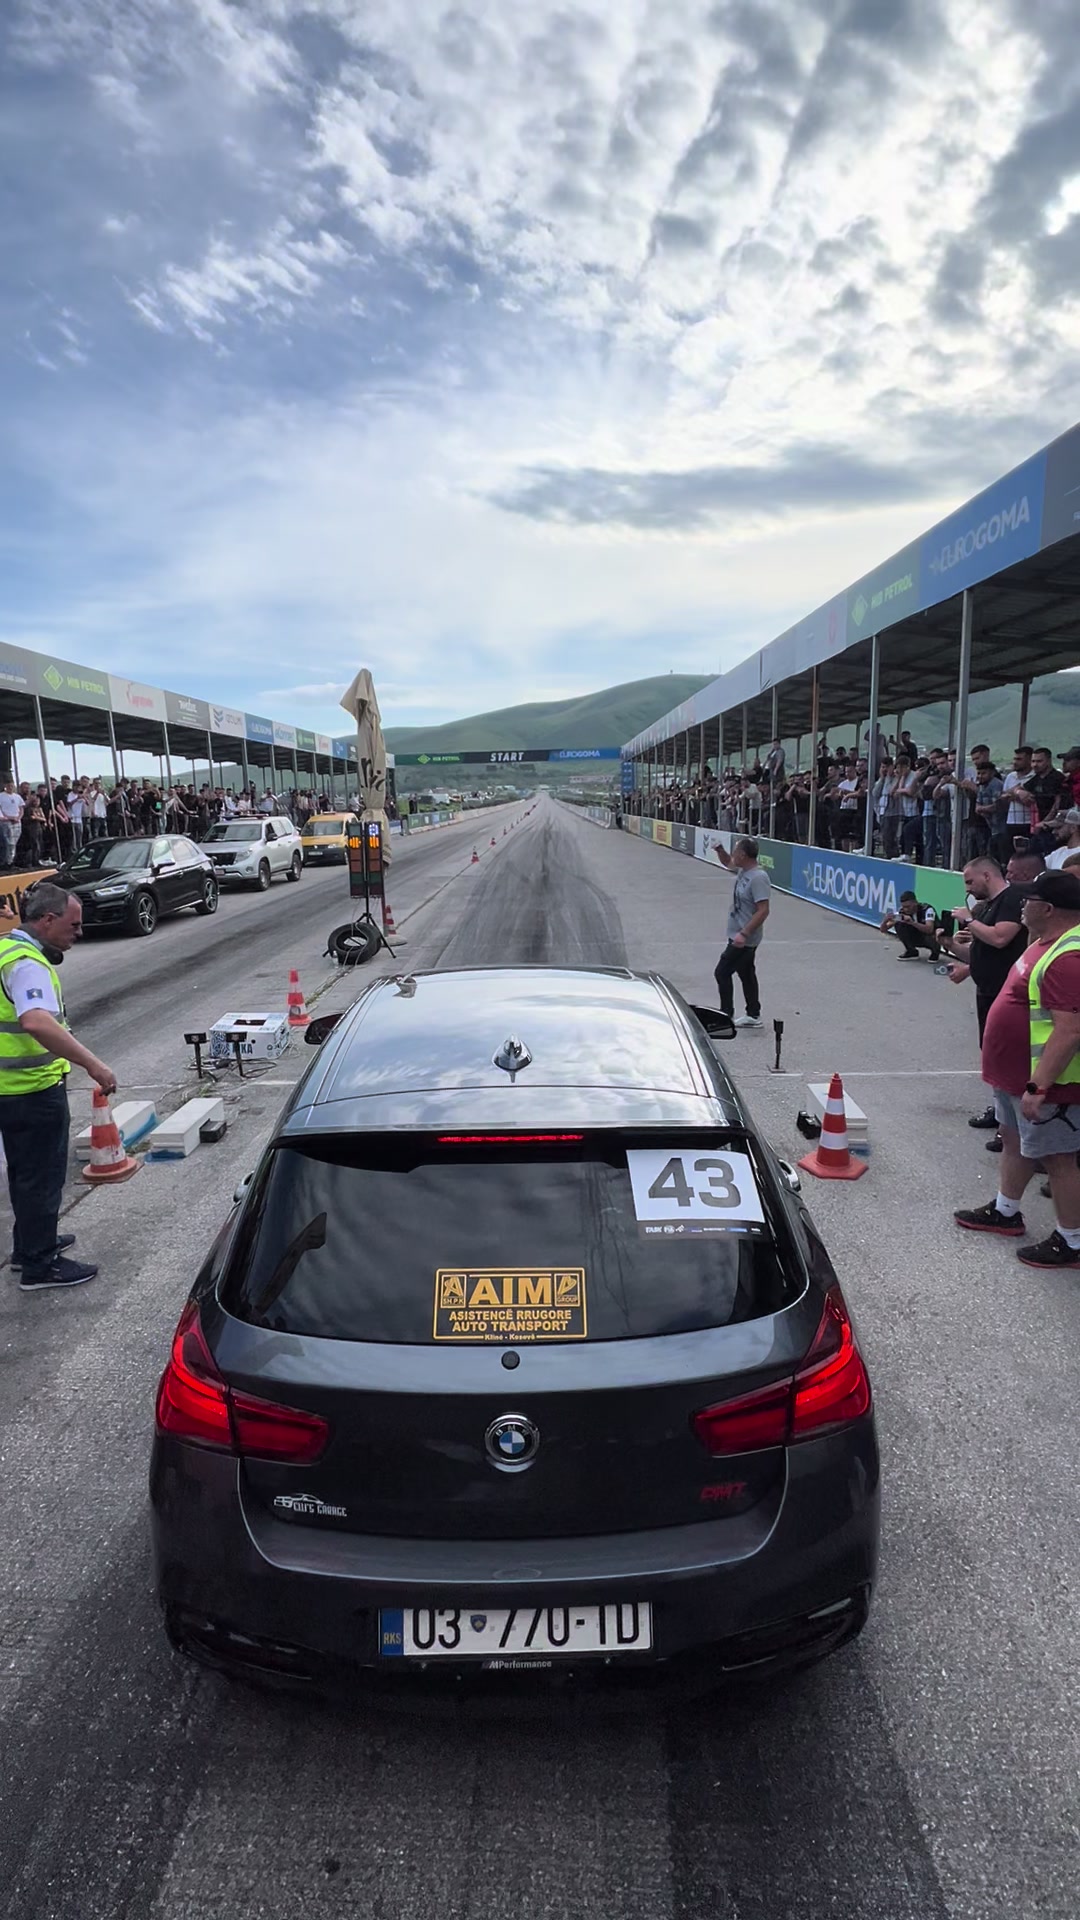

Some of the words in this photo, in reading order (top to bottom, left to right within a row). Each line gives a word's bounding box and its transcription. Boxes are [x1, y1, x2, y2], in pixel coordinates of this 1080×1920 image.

[939, 496, 1030, 572] EUROGOMA
[490, 752, 524, 761] START
[560, 750, 600, 758] EUROGOMA
[813, 862, 897, 914] EUROGOMA
[648, 1157, 741, 1208] 43
[469, 1278, 552, 1304] AIM
[449, 1309, 513, 1321] ASISTENCË
[516, 1310, 571, 1320] RRUGORE
[452, 1321, 487, 1332] AUTO
[491, 1320, 568, 1331] TRANSPORT
[413, 1608, 461, 1649] 03
[384, 1632, 401, 1645] RKS
